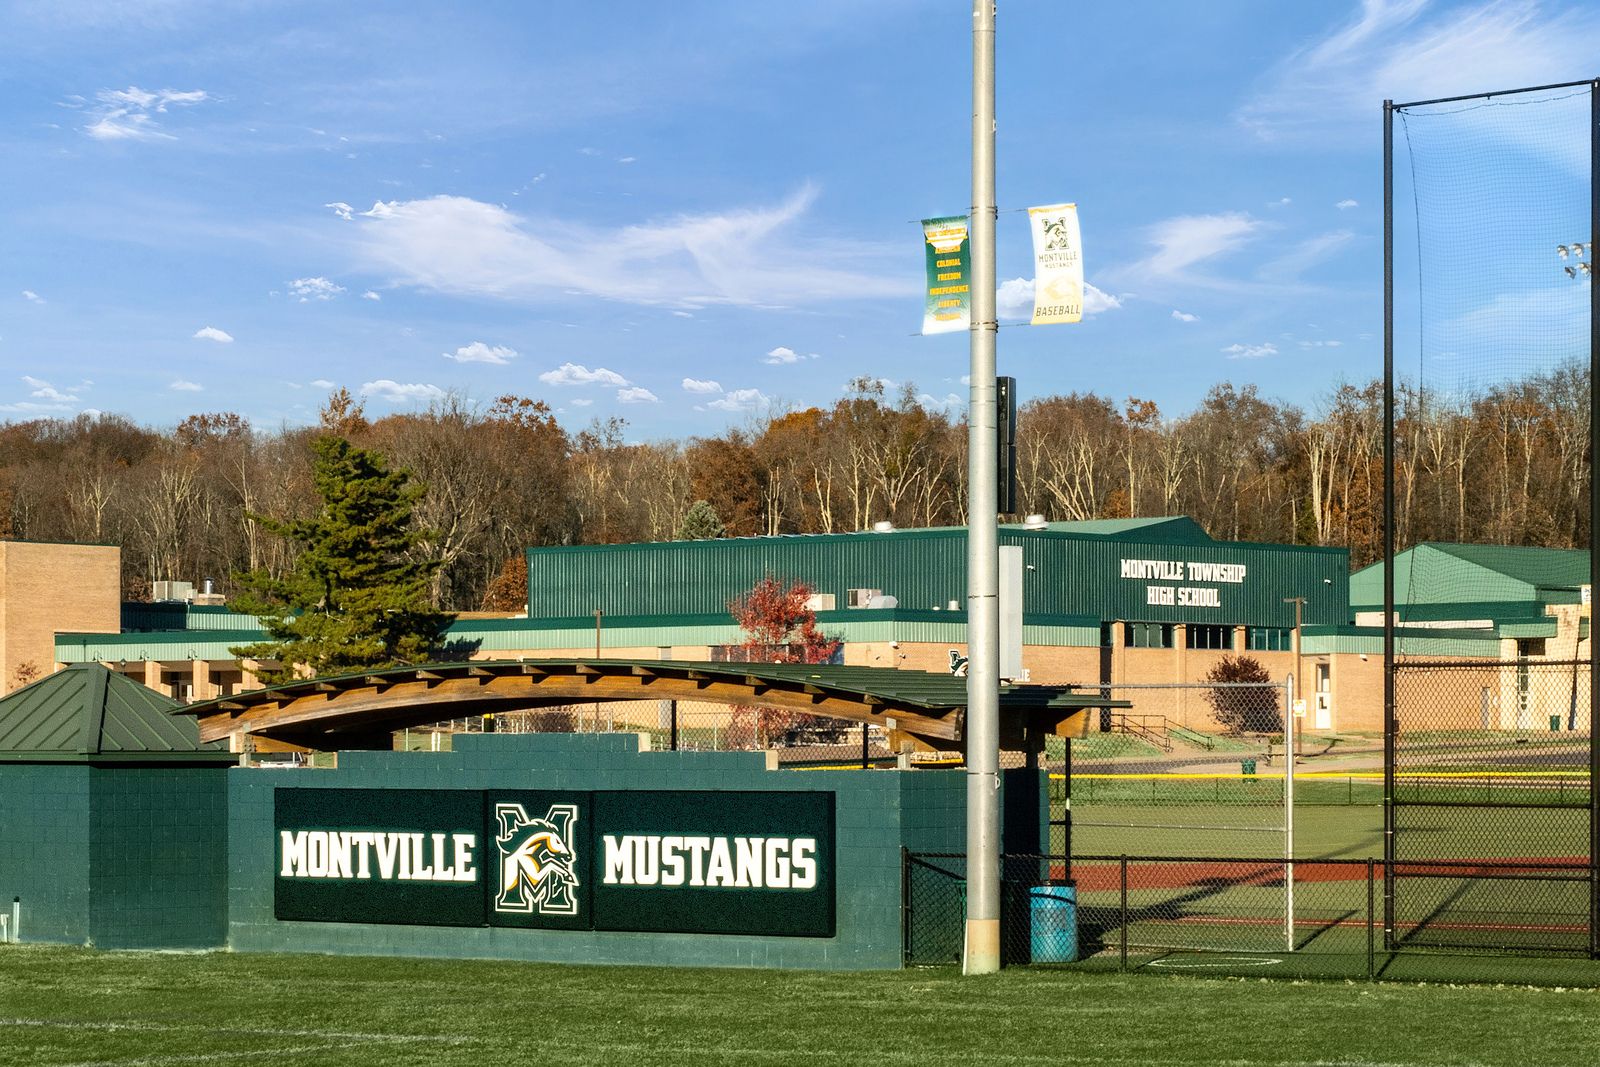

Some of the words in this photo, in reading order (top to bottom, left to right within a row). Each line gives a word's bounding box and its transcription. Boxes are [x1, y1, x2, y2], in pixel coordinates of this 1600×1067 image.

[936, 258, 961, 268] COLONIAL
[1038, 251, 1078, 263] MONTVILLE
[937, 271, 961, 281] FREEDOM
[929, 284, 968, 296] INDEPENDENCE
[1035, 304, 1081, 317] BASEBALL
[1120, 558, 1184, 580] MONTVILLE
[1187, 562, 1246, 583] TOWNSHIP
[1147, 585, 1175, 606] HIGH
[1178, 587, 1221, 607] SCHOOL
[280, 830, 476, 882] MONTVILLE
[603, 835, 816, 889] MUSTANGS
